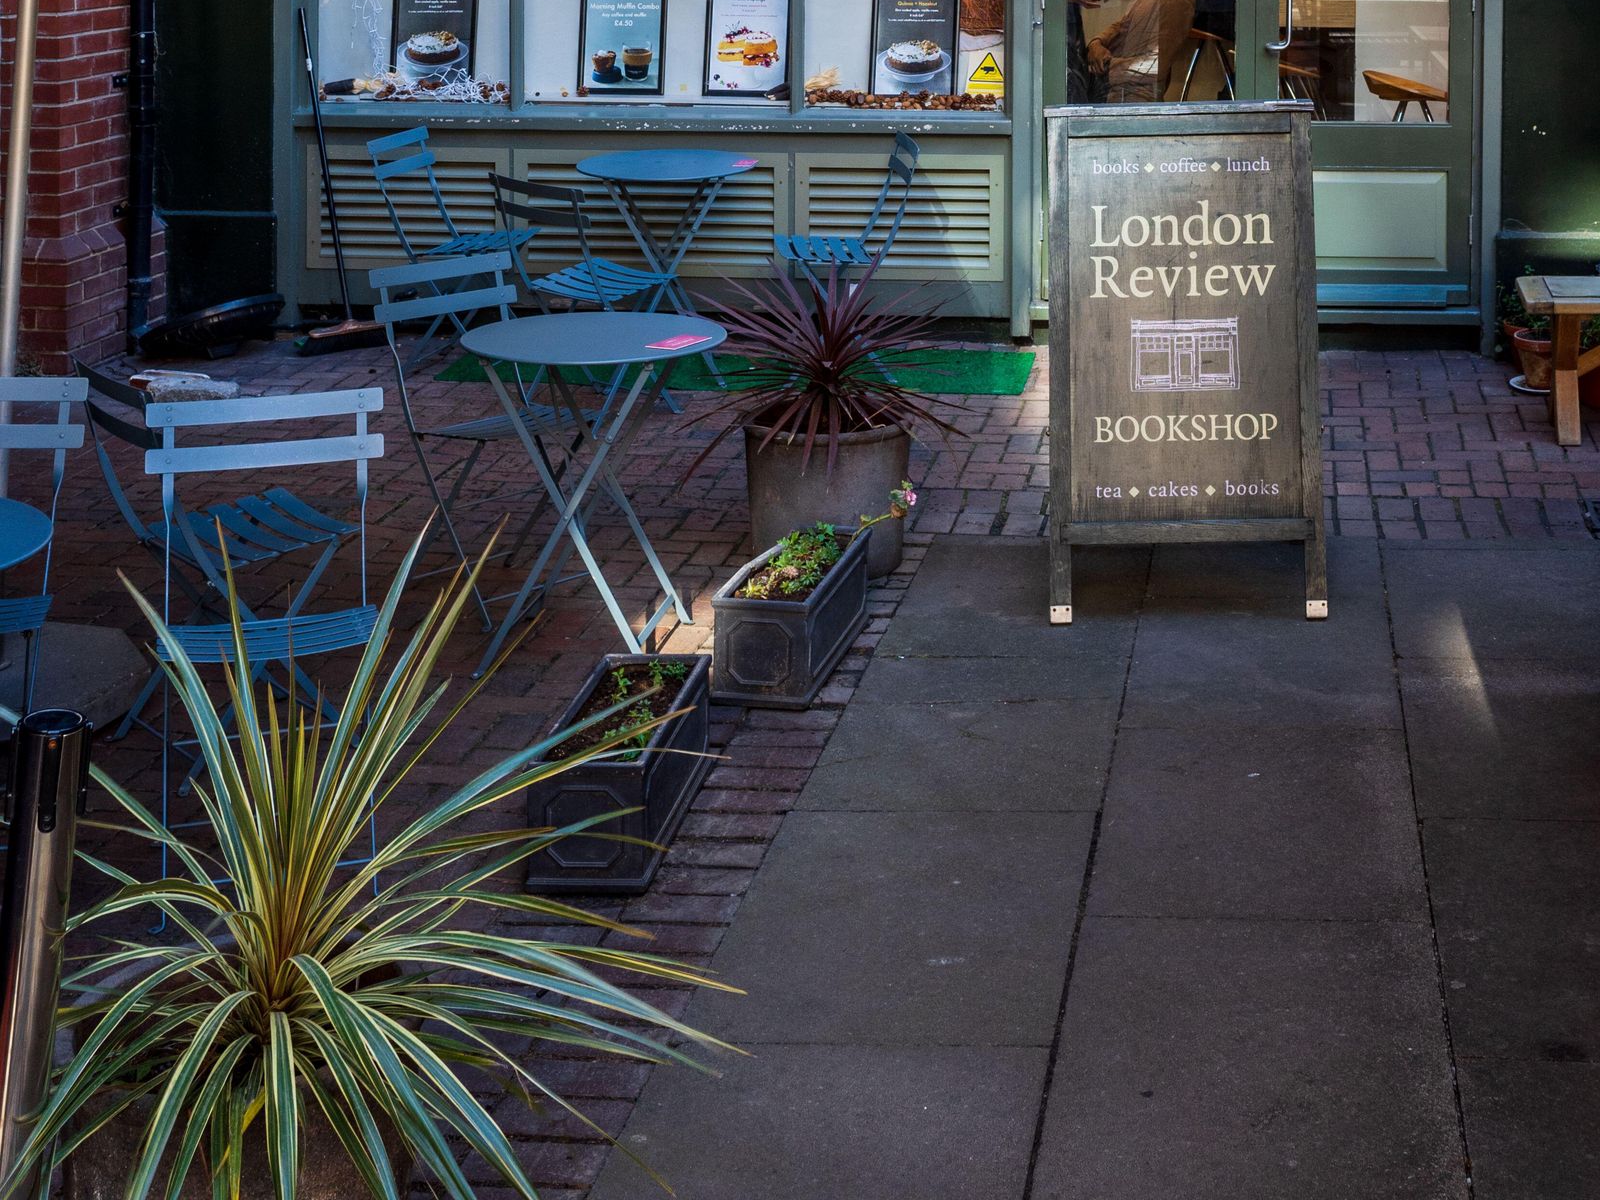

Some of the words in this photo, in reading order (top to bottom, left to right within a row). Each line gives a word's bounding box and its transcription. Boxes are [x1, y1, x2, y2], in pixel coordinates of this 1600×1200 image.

[589, 2, 616, 11] Morning
[616, 2, 636, 10] Muffin
[637, 2, 660, 10] Combo
[1092, 159, 1140, 175] books
[1159, 156, 1207, 174] coffee
[1226, 156, 1271, 172] lunch
[1089, 199, 1274, 247] London
[1089, 251, 1276, 298] Review
[1094, 413, 1278, 443] BOOKSHOP
[1095, 484, 1122, 498] tea
[1148, 480, 1198, 497] cakes
[1225, 479, 1279, 496] books
